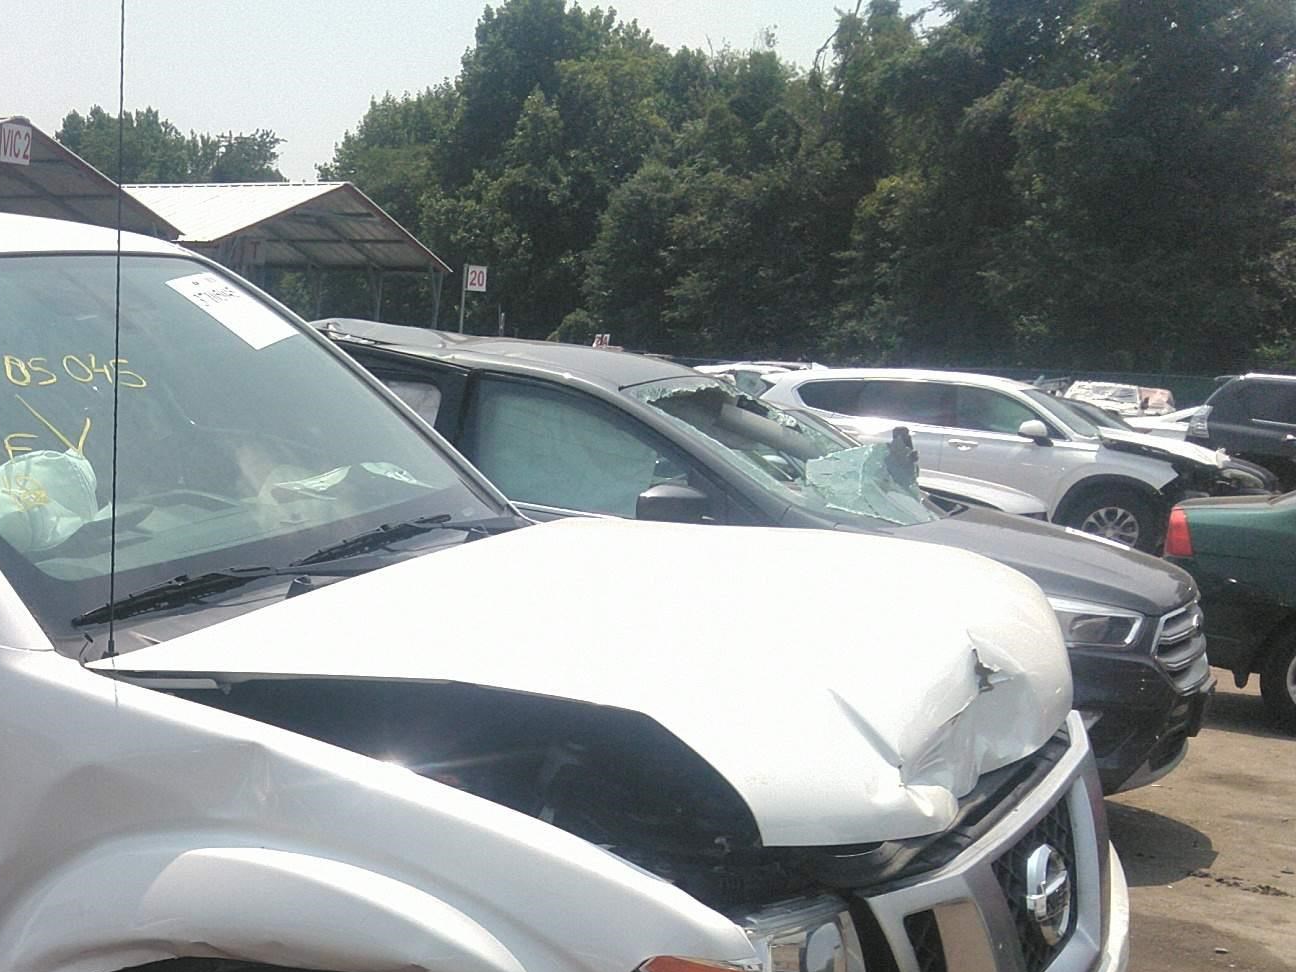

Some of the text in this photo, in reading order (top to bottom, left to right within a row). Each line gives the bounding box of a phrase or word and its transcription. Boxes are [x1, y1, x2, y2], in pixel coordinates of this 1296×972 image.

[3, 127, 31, 160] VIC 2
[469, 270, 485, 287] 20
